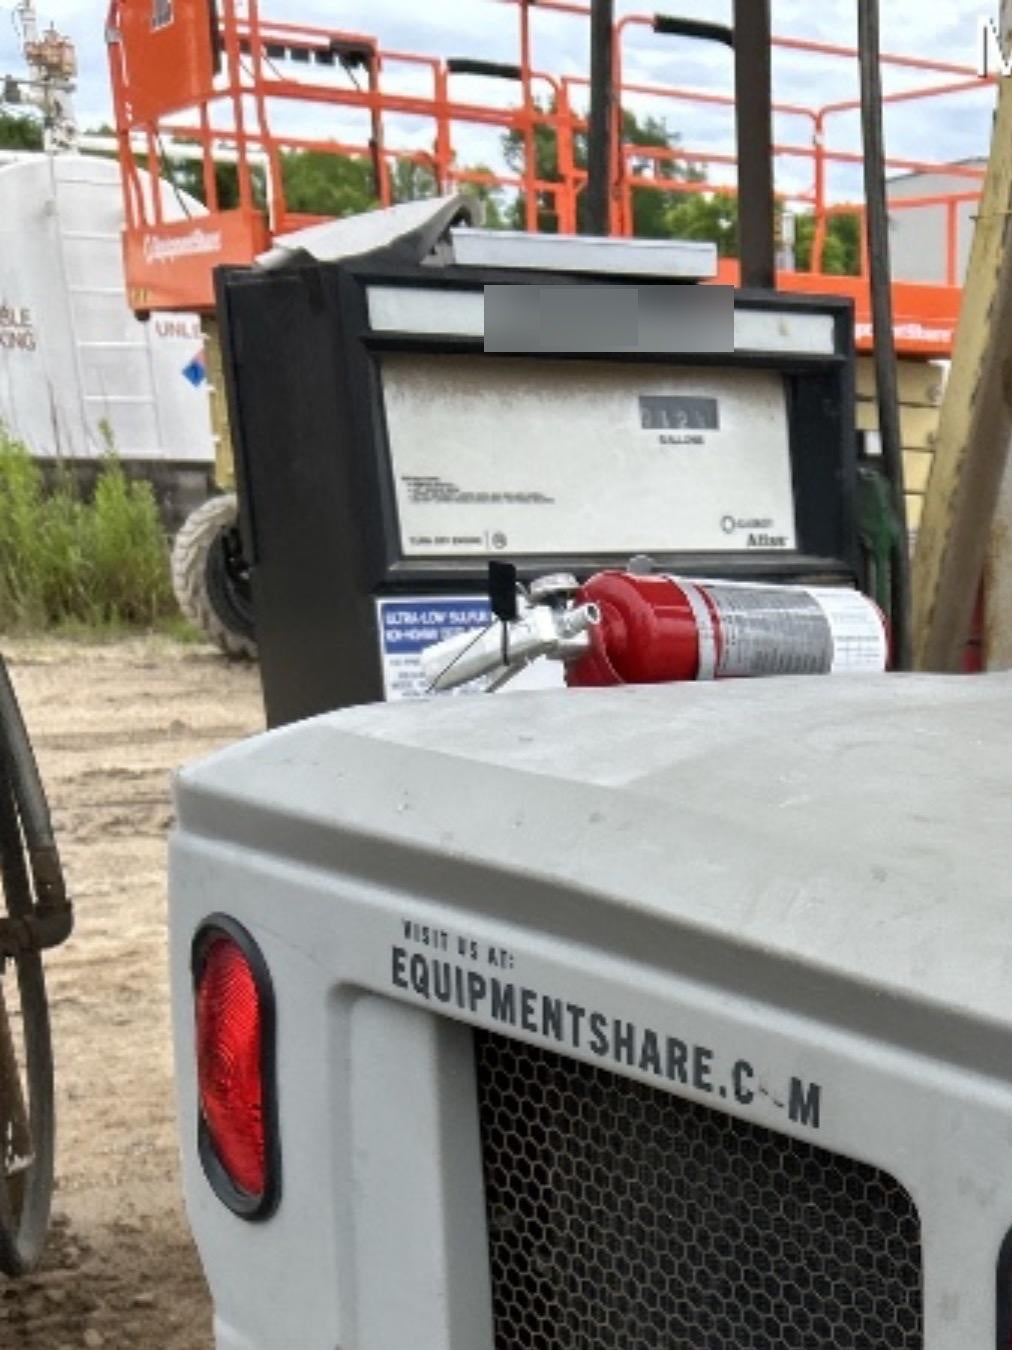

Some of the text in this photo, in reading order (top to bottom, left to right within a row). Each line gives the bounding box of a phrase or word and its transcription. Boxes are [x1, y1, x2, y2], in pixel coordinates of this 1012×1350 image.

[402, 919, 448, 951] VISIT
[458, 936, 477, 960] US
[391, 945, 821, 1129] EQUIPMENTSHARE.CM
